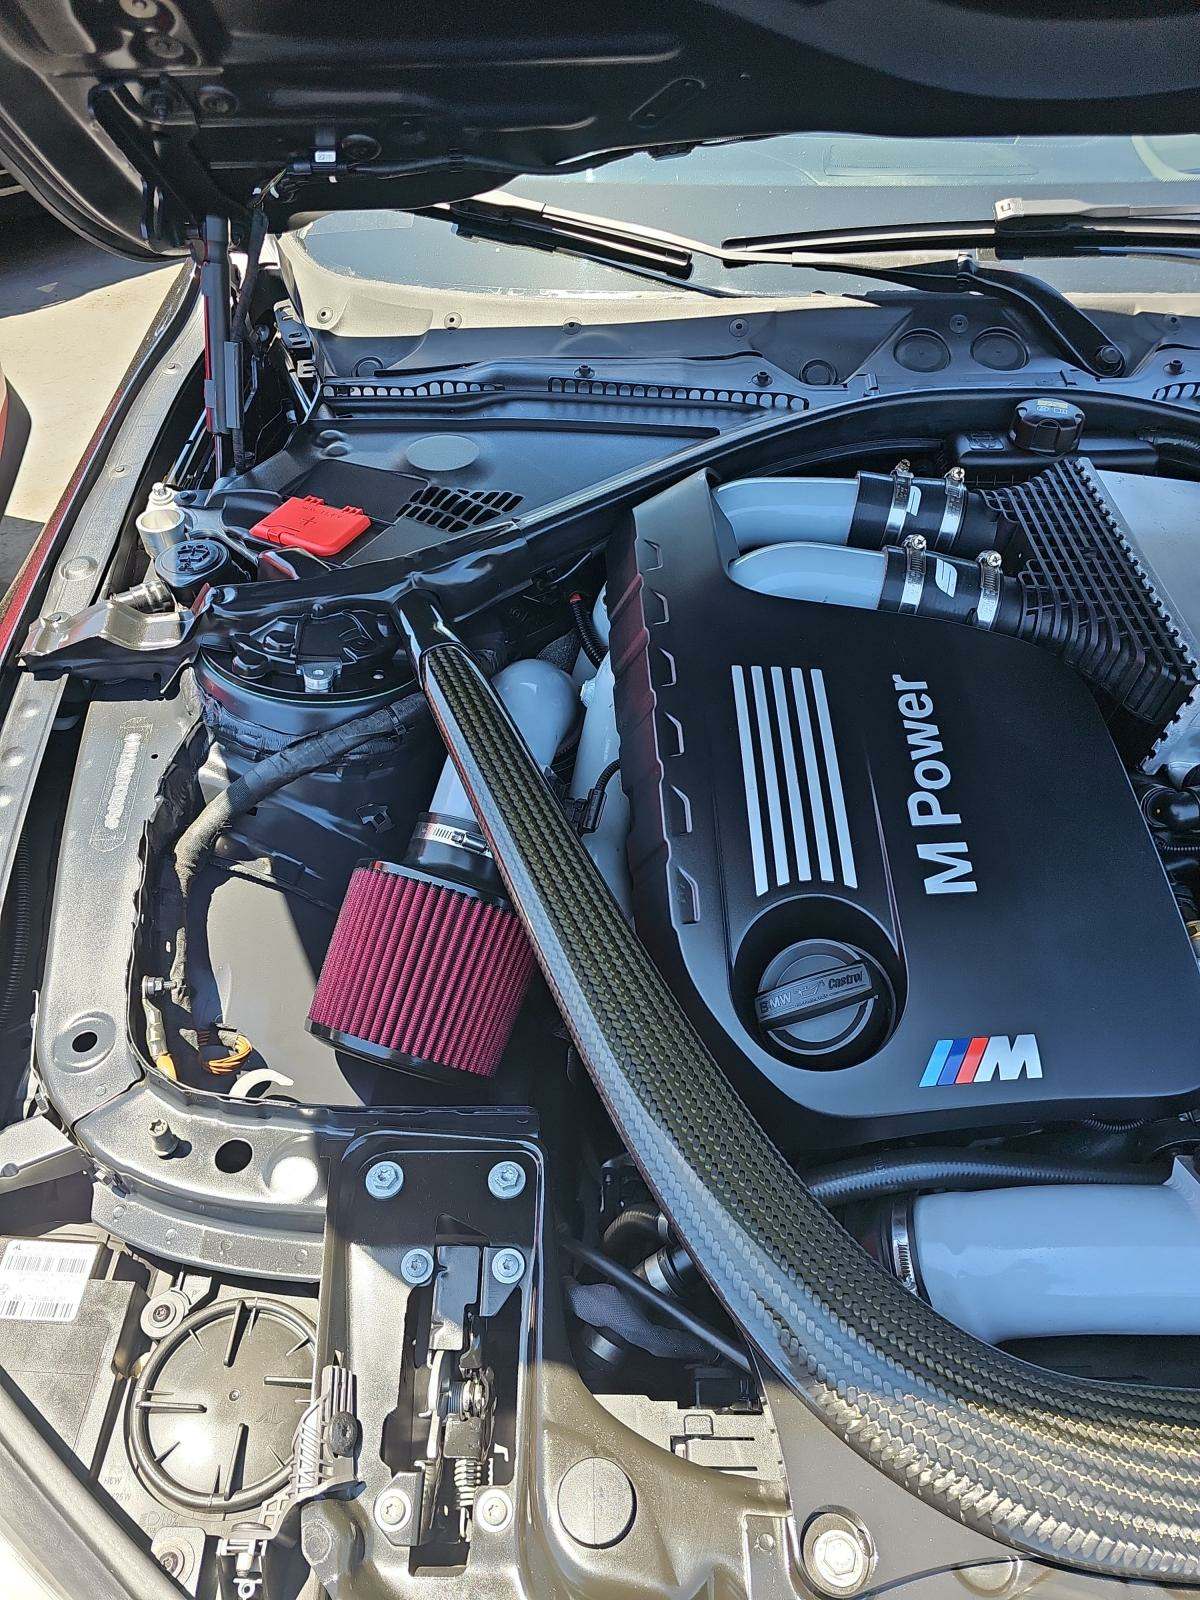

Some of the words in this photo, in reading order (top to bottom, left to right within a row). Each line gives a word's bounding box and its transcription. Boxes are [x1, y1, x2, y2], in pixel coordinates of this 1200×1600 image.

[892, 674, 962, 827] Power
[916, 841, 978, 895] M
[760, 991, 792, 1014] BMW
[828, 971, 863, 990] Castrol
[973, 1034, 1043, 1083] M
